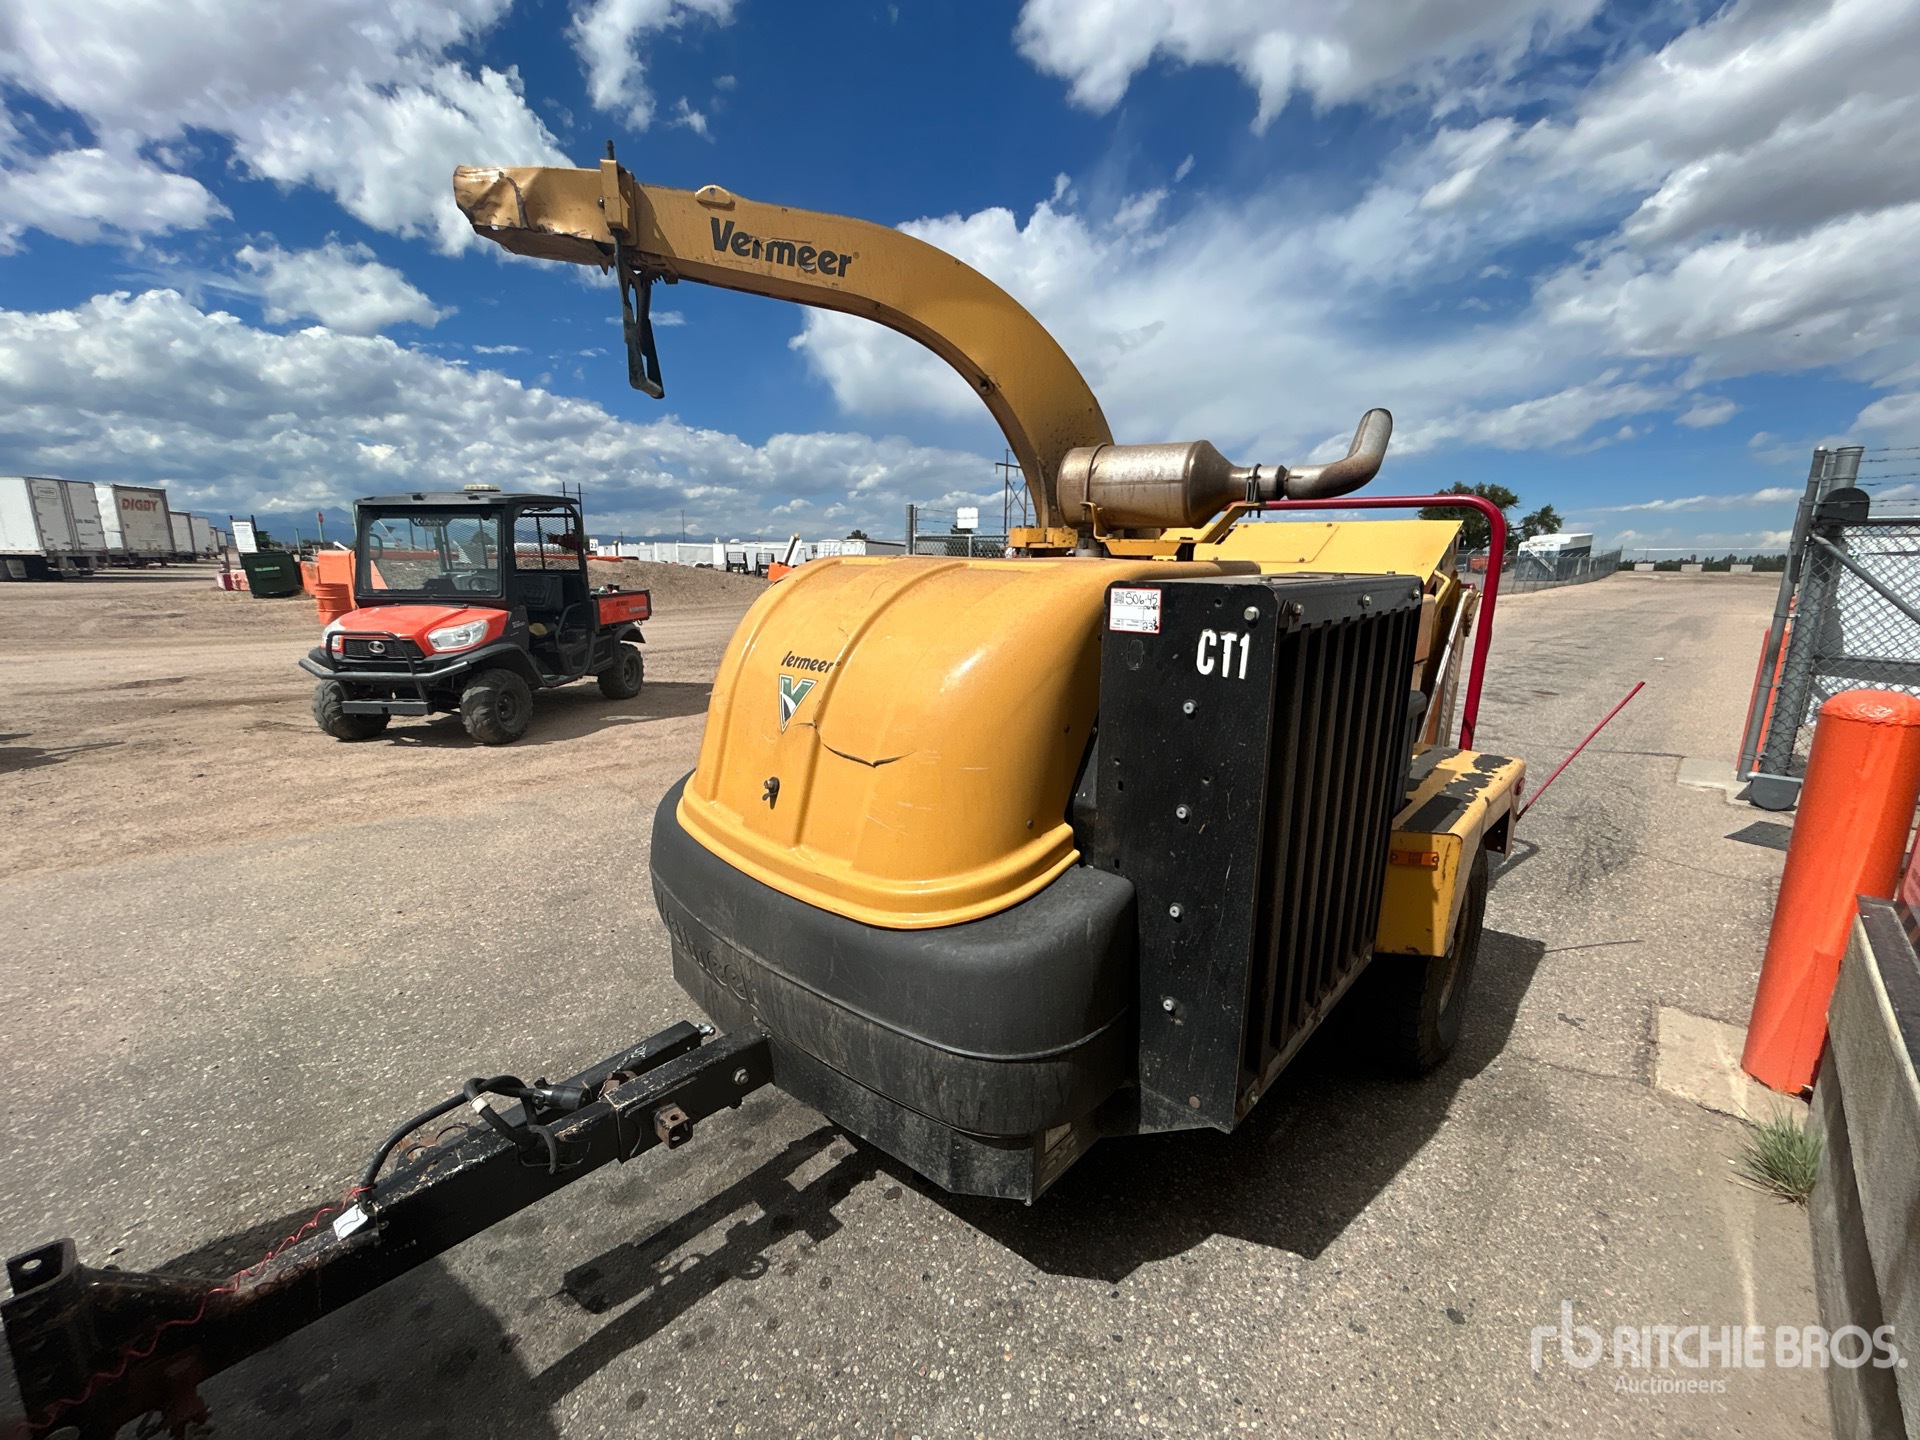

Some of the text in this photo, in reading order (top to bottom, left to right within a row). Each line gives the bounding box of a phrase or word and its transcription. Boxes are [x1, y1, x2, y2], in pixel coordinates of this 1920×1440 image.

[710, 217, 852, 277] Vermeer
[121, 498, 158, 513] DIGBY
[1196, 628, 1250, 680] CT1
